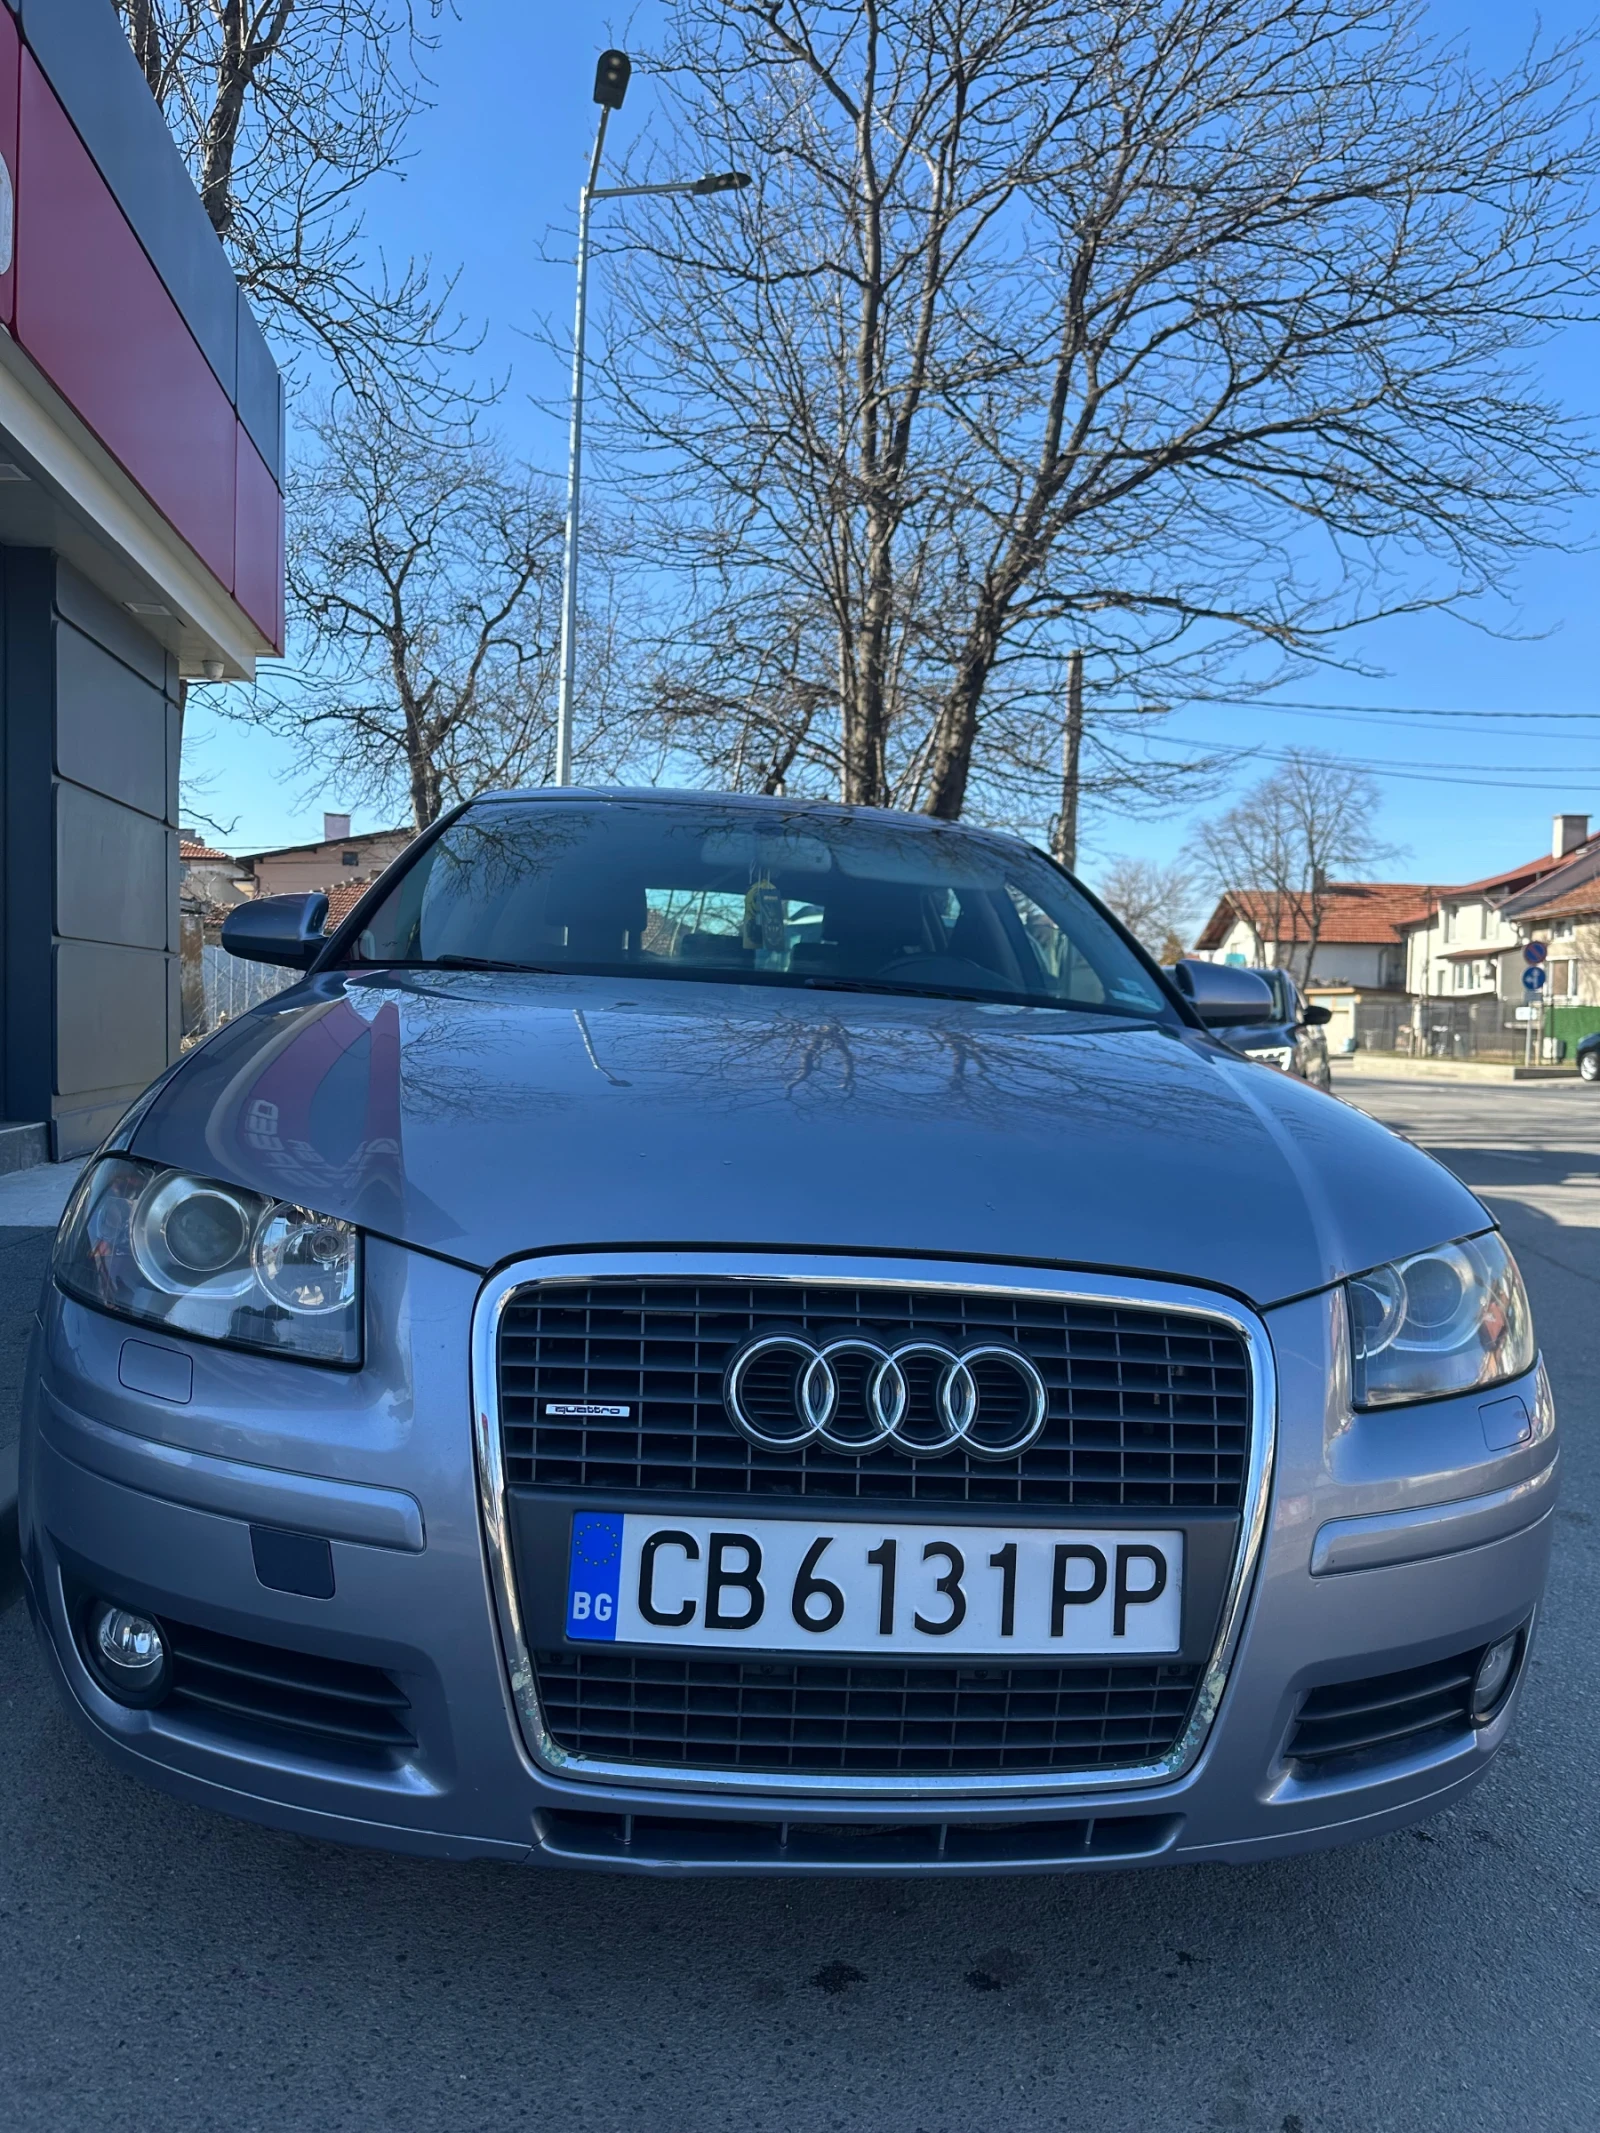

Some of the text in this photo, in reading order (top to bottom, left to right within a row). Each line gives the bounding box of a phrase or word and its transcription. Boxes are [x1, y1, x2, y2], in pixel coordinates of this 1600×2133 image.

[552, 1405, 620, 1415] quattro
[637, 1530, 1167, 1637] CB 6131 PP
[572, 1591, 613, 1621] BG
